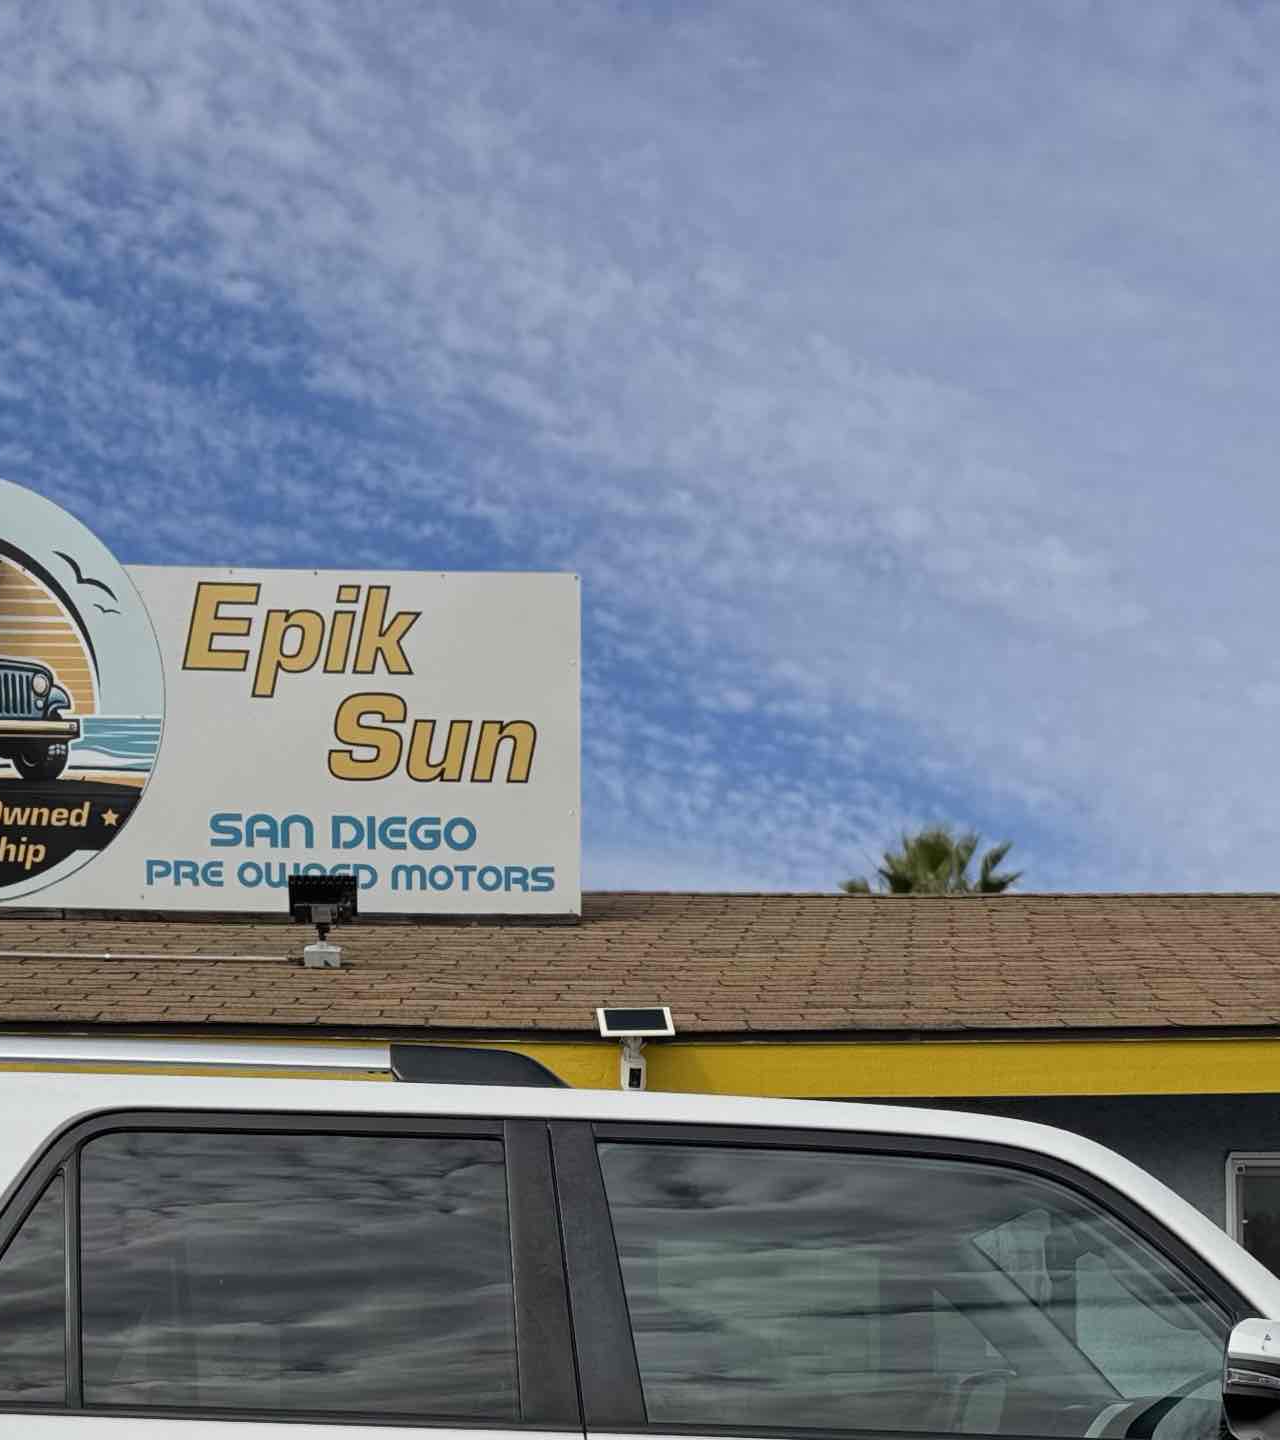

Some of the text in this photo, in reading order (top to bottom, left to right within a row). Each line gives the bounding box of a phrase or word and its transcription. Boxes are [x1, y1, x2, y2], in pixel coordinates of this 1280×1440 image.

[182, 582, 422, 698] Epik
[328, 692, 537, 783] Sun
[209, 813, 477, 851] SAN DIEGO
[145, 859, 224, 887] PRE
[391, 864, 555, 892] MOTORS
